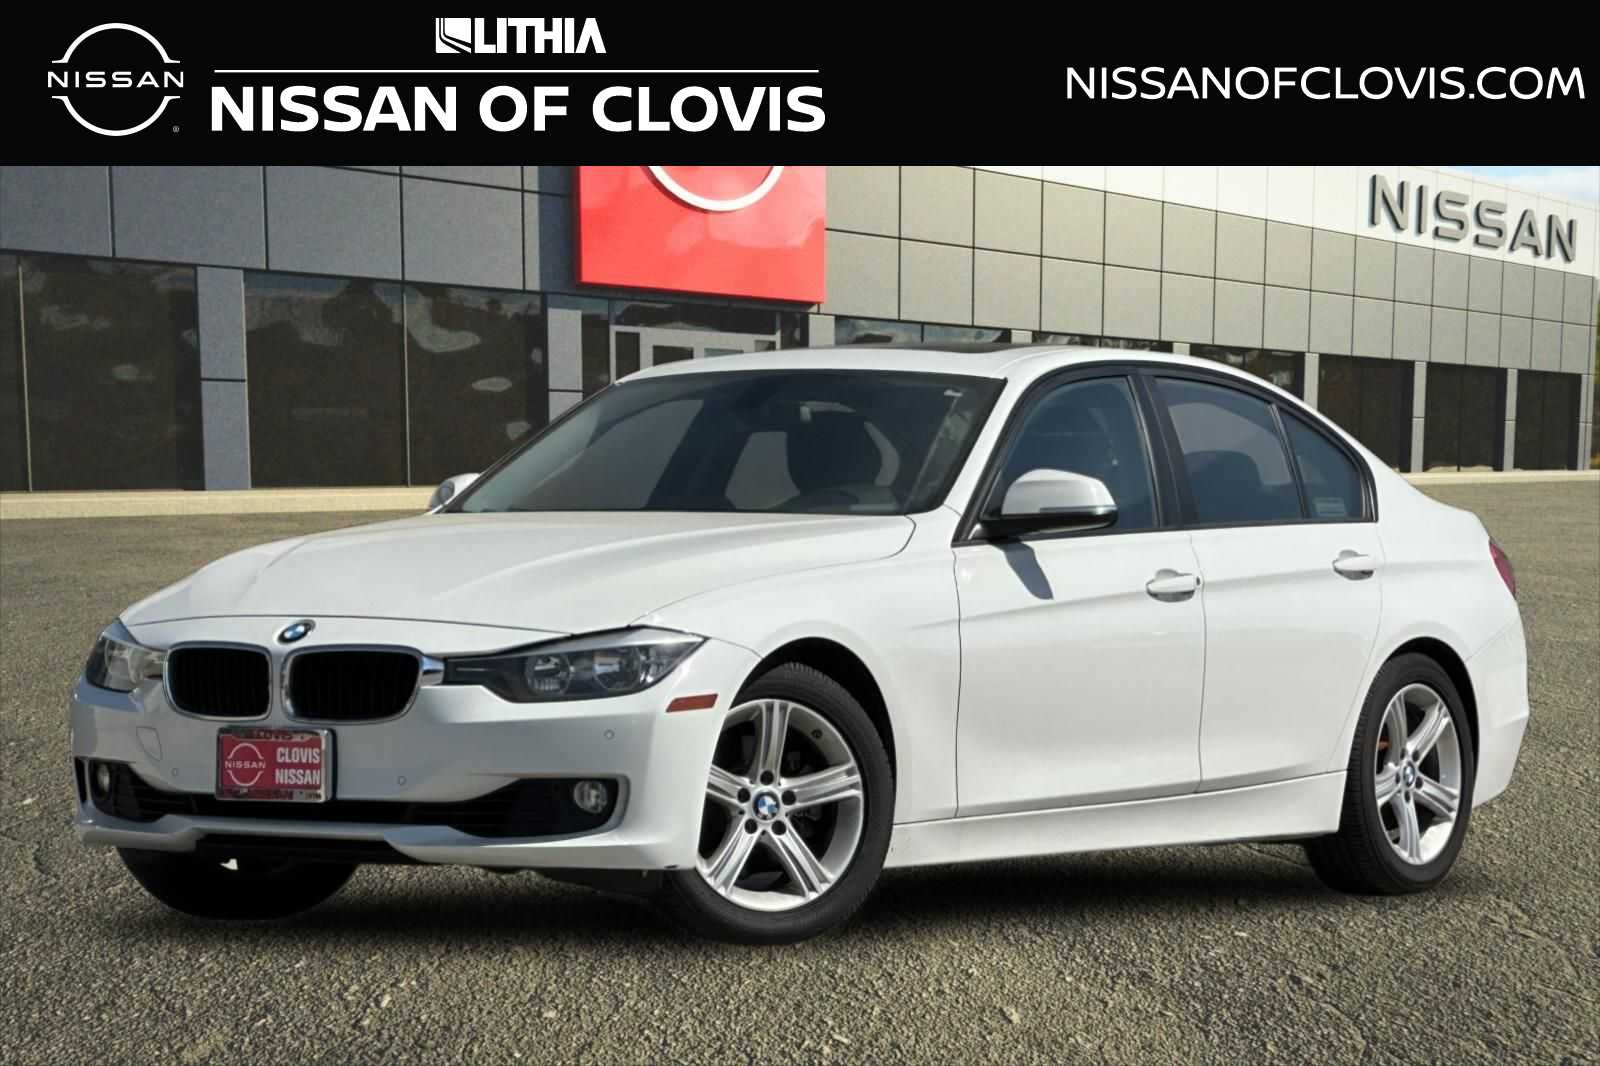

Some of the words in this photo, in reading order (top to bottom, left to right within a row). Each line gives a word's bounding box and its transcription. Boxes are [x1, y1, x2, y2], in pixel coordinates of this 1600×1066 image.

[1369, 174, 1577, 262] NISSAN
[276, 747, 320, 764] CLOVIS
[225, 760, 266, 769] NISSAN
[275, 769, 320, 784] NISSAN
